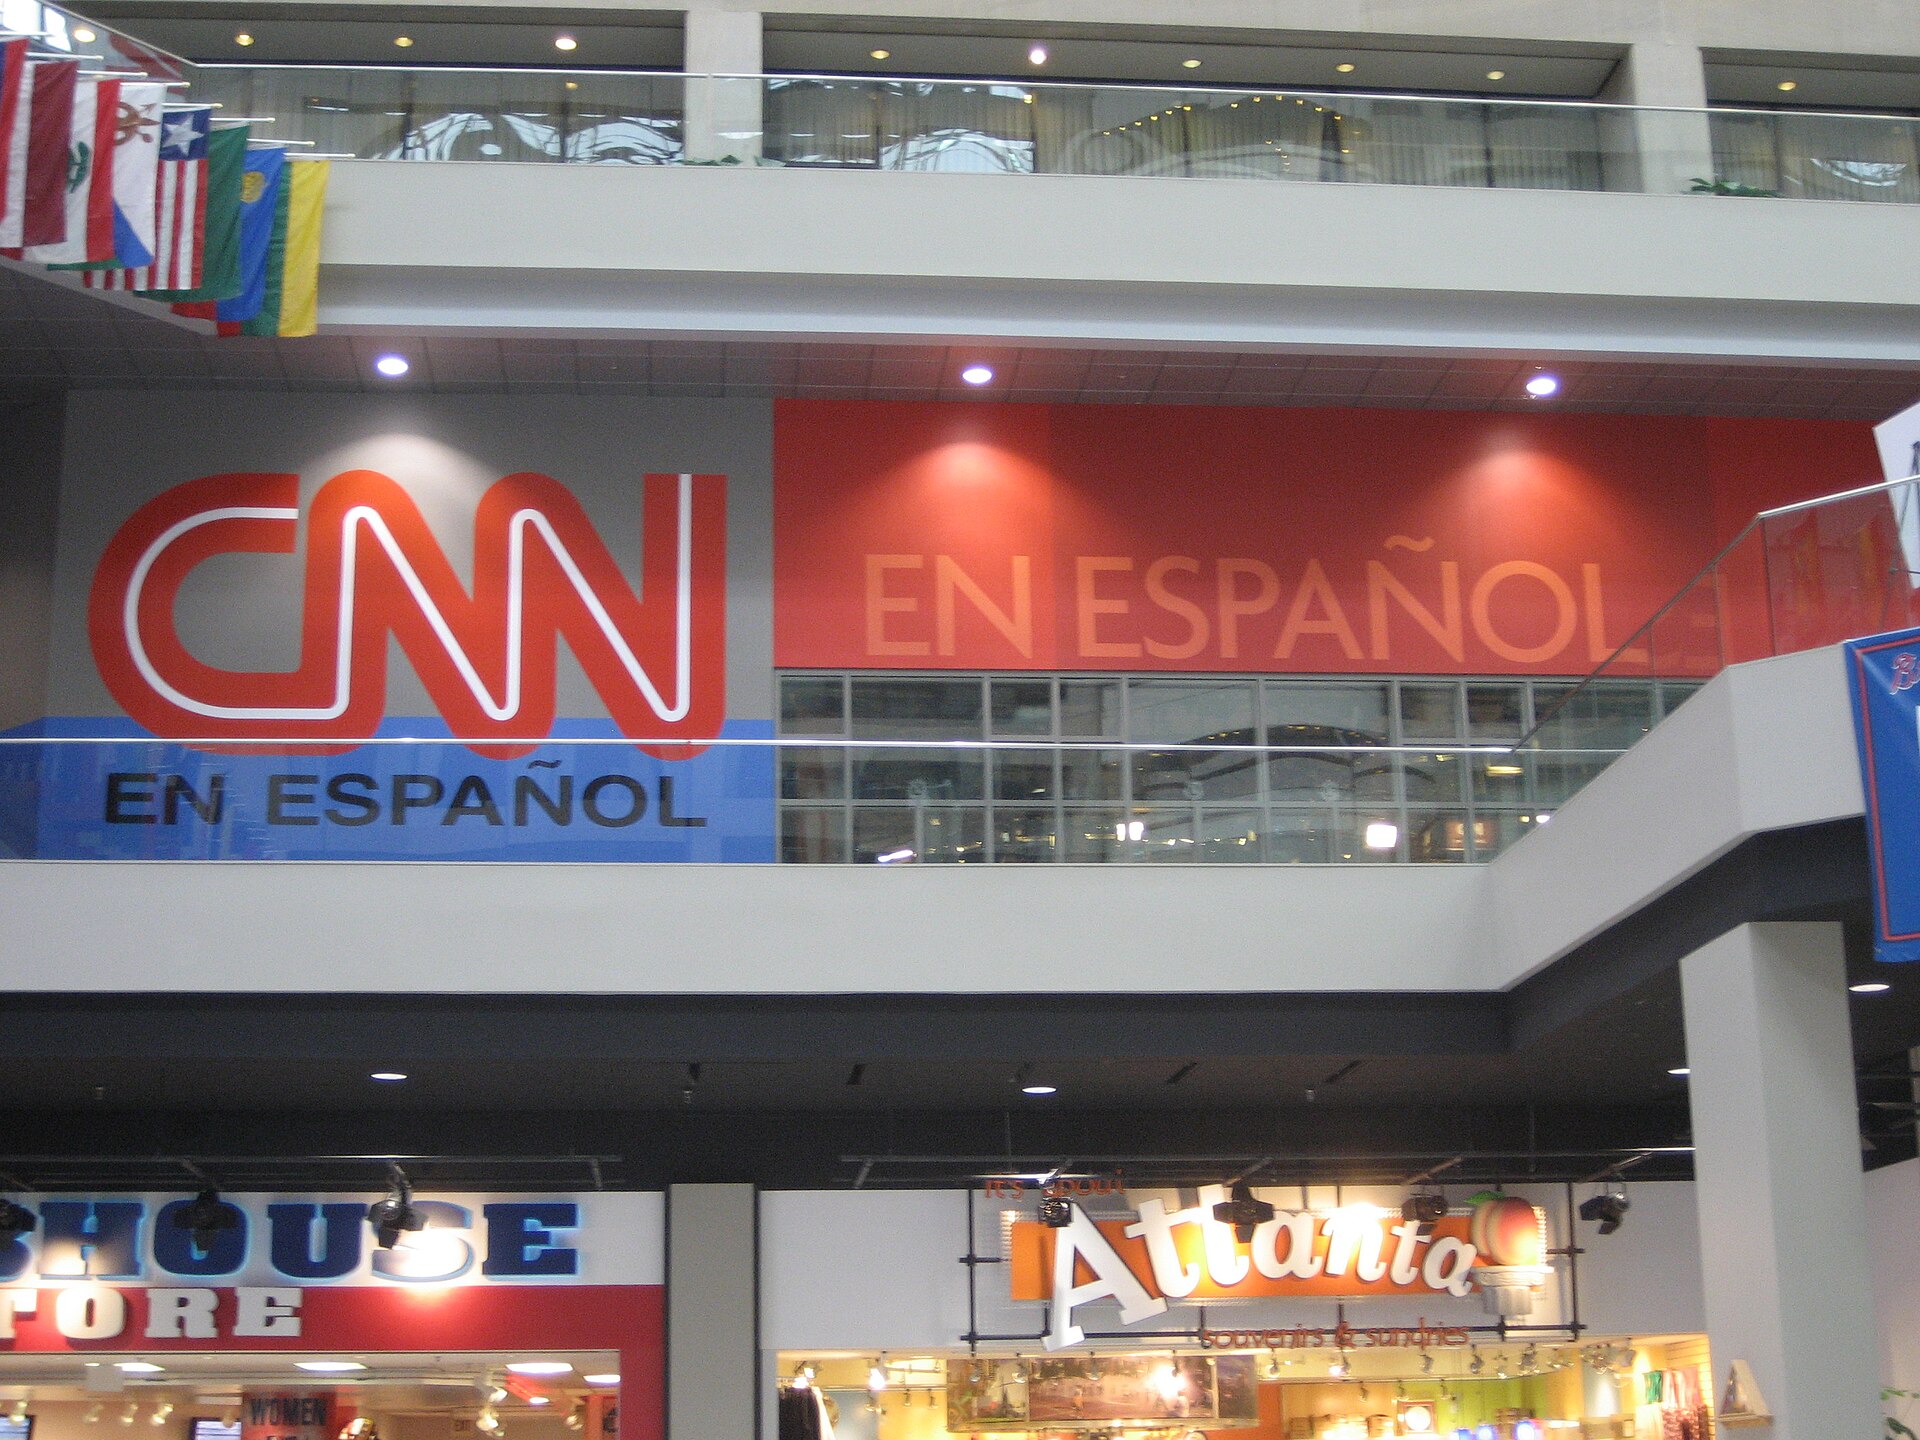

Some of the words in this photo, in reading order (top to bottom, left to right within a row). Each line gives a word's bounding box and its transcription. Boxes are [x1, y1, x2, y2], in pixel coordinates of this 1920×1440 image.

[88, 470, 727, 760] CNN
[865, 554, 1032, 658] EN
[1076, 535, 1649, 664] ESPAÑOL
[105, 772, 224, 825] EN
[267, 759, 707, 828] ESPAÑOL
[0, 1199, 582, 1284] HOUSE
[1042, 1184, 1478, 1351] Atlanta
[1203, 1323, 1324, 1349] souvenirs
[1333, 1320, 1357, 1348] &
[1366, 1316, 1470, 1350] sundries
[251, 1397, 328, 1425] WOMEN
